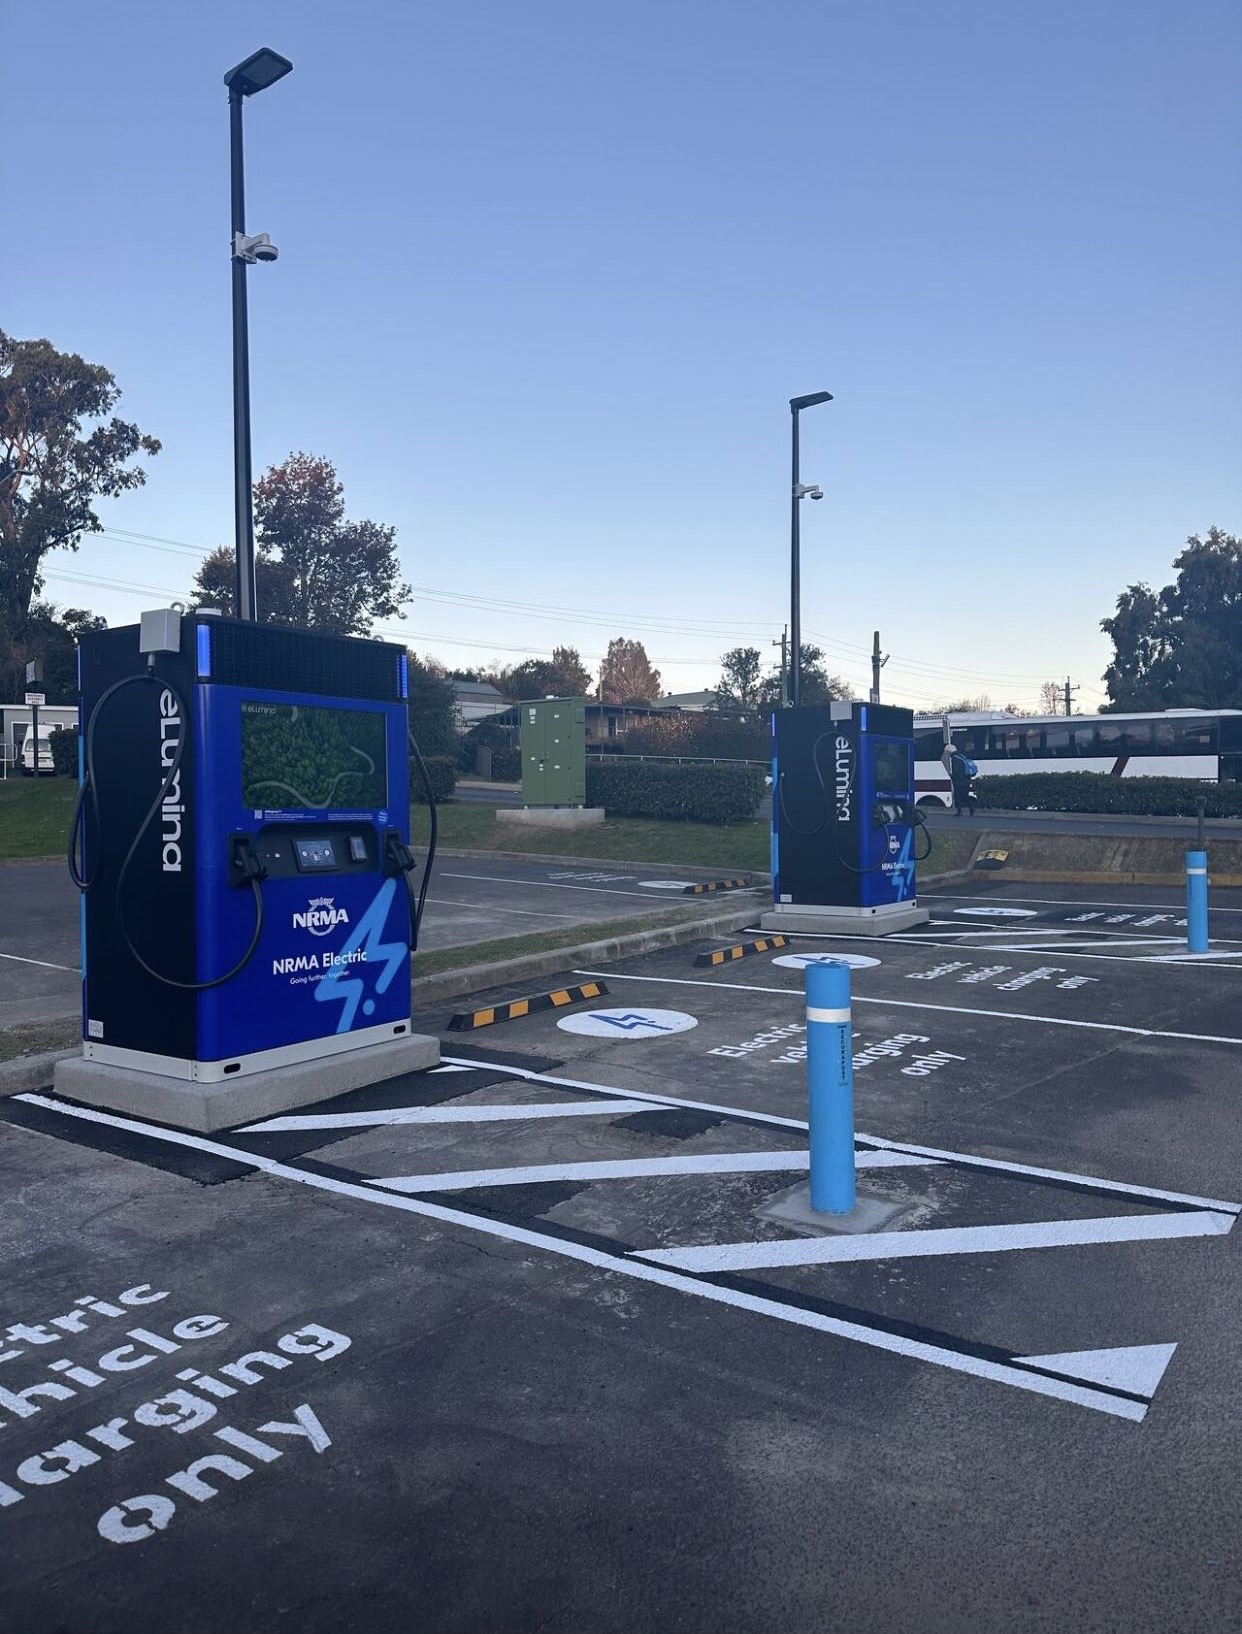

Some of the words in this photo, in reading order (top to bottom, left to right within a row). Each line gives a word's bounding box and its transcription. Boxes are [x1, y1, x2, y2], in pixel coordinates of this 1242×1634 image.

[293, 909, 349, 929] NRMA
[273, 955, 319, 975] NRMA
[322, 948, 367, 968] Electric
[290, 977, 308, 985] Going
[705, 1023, 808, 1058] Electric
[851, 1033, 931, 1070] arging
[901, 1050, 967, 1076] only
[0, 1284, 171, 1363] tric
[0, 1314, 231, 1429] hicle
[0, 1323, 352, 1506] arging
[97, 1403, 333, 1543] only
